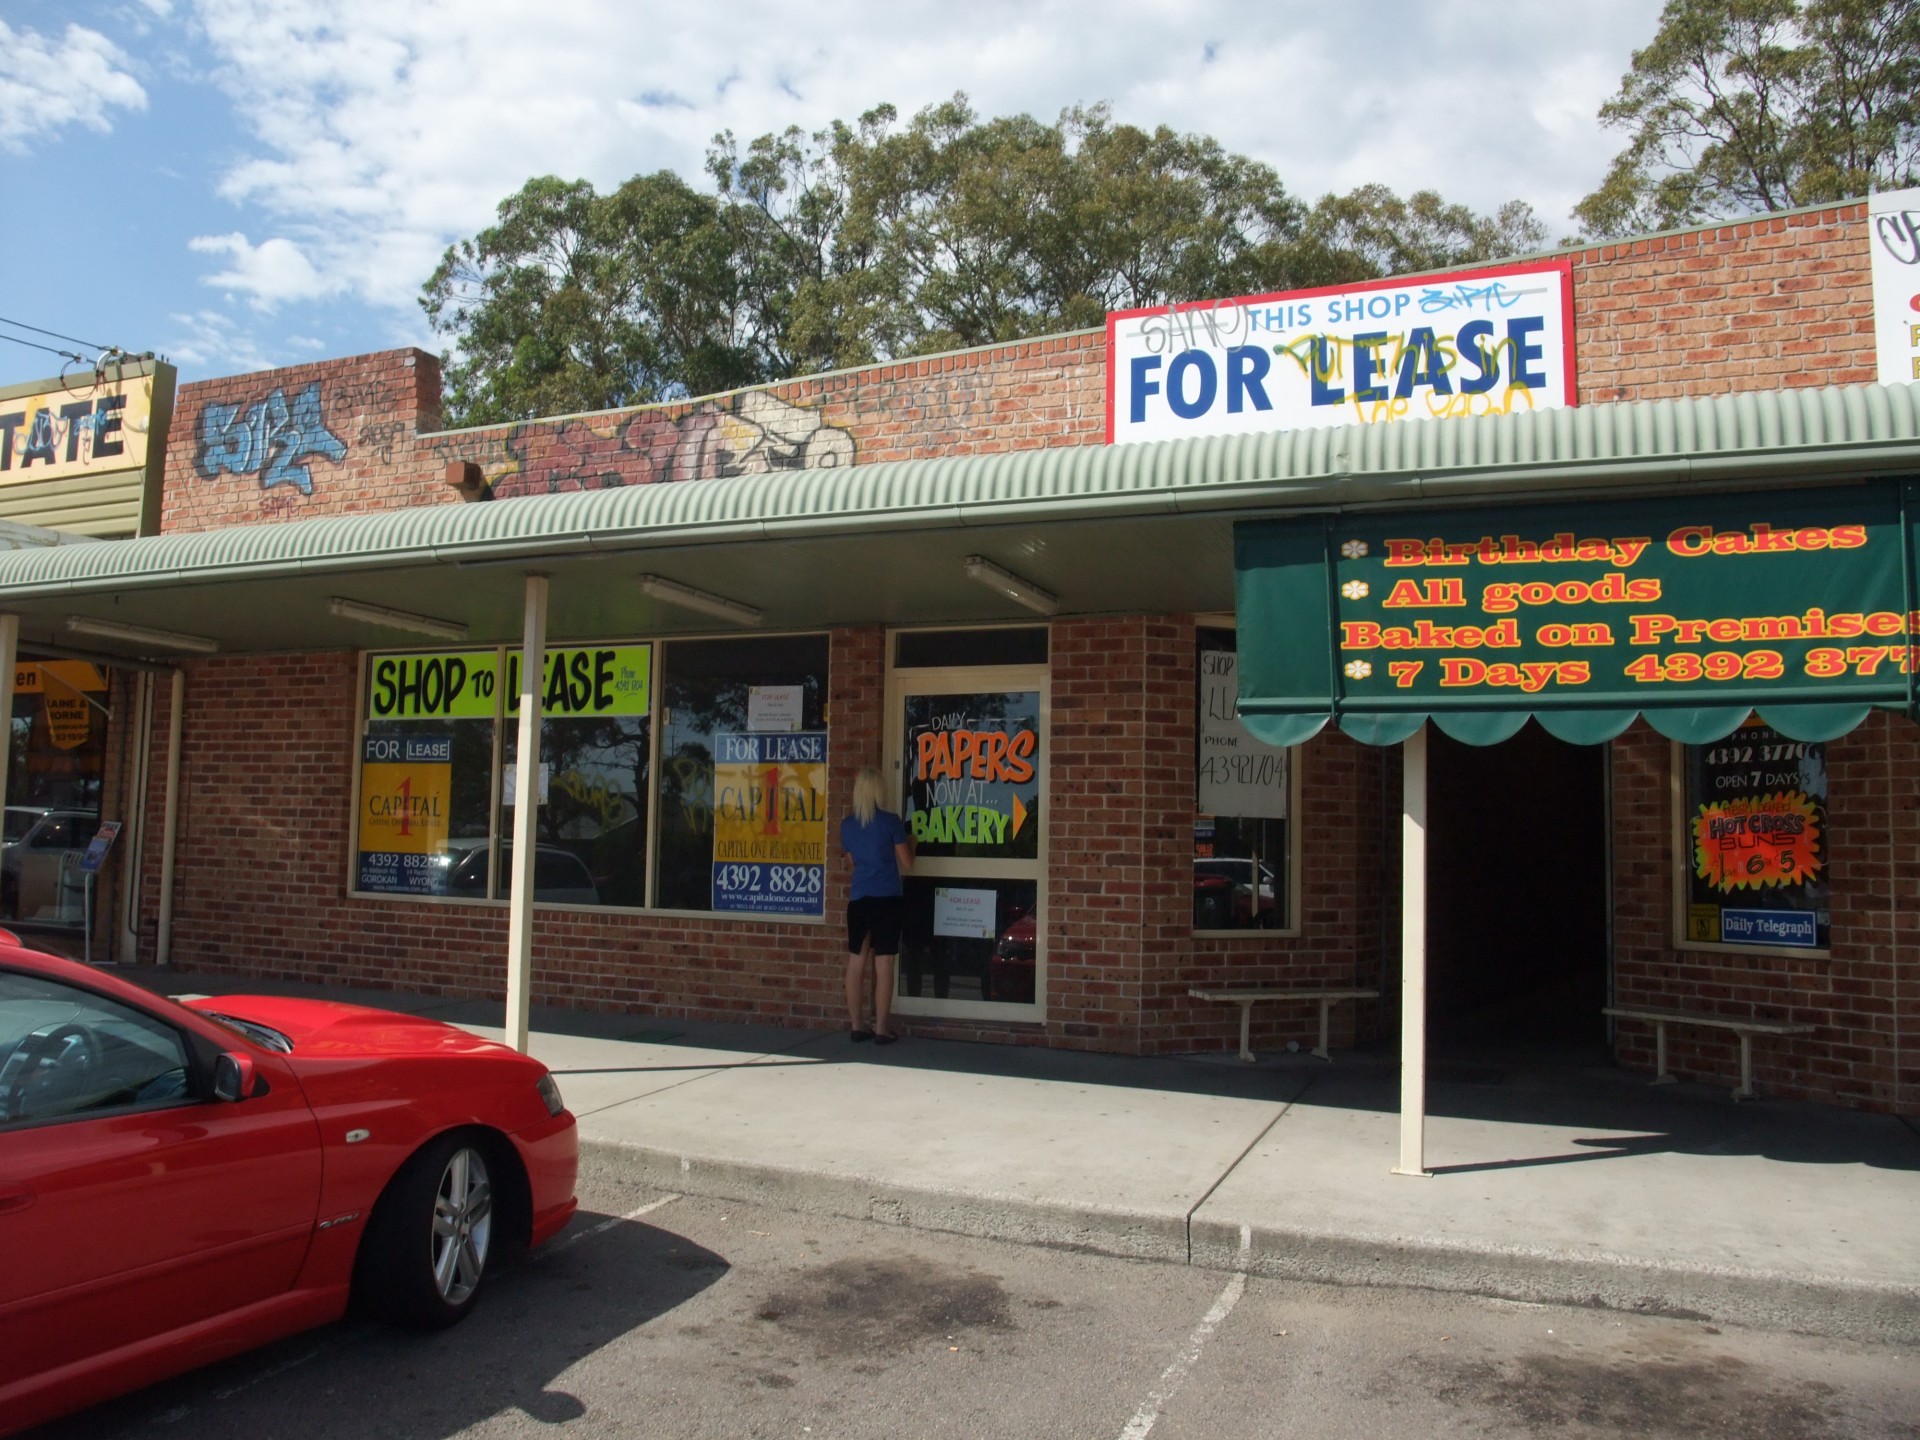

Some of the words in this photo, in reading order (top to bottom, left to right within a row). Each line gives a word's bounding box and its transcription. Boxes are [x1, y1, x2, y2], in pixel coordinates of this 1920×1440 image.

[1248, 303, 1312, 332] THIS
[1328, 293, 1411, 324] SHOP
[1130, 344, 1273, 424] FOR
[1310, 315, 1547, 406] LEASE
[1383, 532, 1650, 568] Birthday
[1665, 523, 1867, 556] Cakes
[1383, 577, 1466, 608] All
[1481, 573, 1663, 612] goods
[1340, 618, 1522, 650] Baked
[1536, 623, 1615, 647] on
[1203, 655, 1234, 676] SHOP
[1388, 660, 1424, 688] 7
[1439, 657, 1591, 692] Days
[1624, 648, 1785, 683] 4392
[374, 657, 466, 715] SHOP
[471, 670, 495, 698] TO
[507, 650, 617, 712] LASE
[931, 711, 966, 731] DAILY
[366, 740, 401, 759] FOR
[409, 743, 448, 757] LEASE
[726, 736, 760, 761] FOR
[765, 737, 822, 761] LEASE
[917, 729, 1036, 784] PAPERS
[1705, 746, 1753, 765] 4392
[1715, 774, 1748, 789] OPEN
[1750, 771, 1762, 787] 7
[1765, 772, 1799, 787] DAYS
[369, 794, 441, 818] CAPITAL
[719, 785, 824, 823] CAPITAL
[925, 781, 963, 808] NOW
[911, 804, 1010, 845] BAKERY
[1709, 815, 1747, 840] HOT
[1748, 813, 1806, 834] CROSS
[717, 841, 749, 858] CAPITAL
[1719, 832, 1796, 851] BUNS
[368, 853, 399, 867] 4392
[716, 864, 761, 891] 4392
[769, 866, 822, 893] 8828
[1725, 917, 1754, 935] Daily
[1755, 919, 1812, 937] Telegraph
